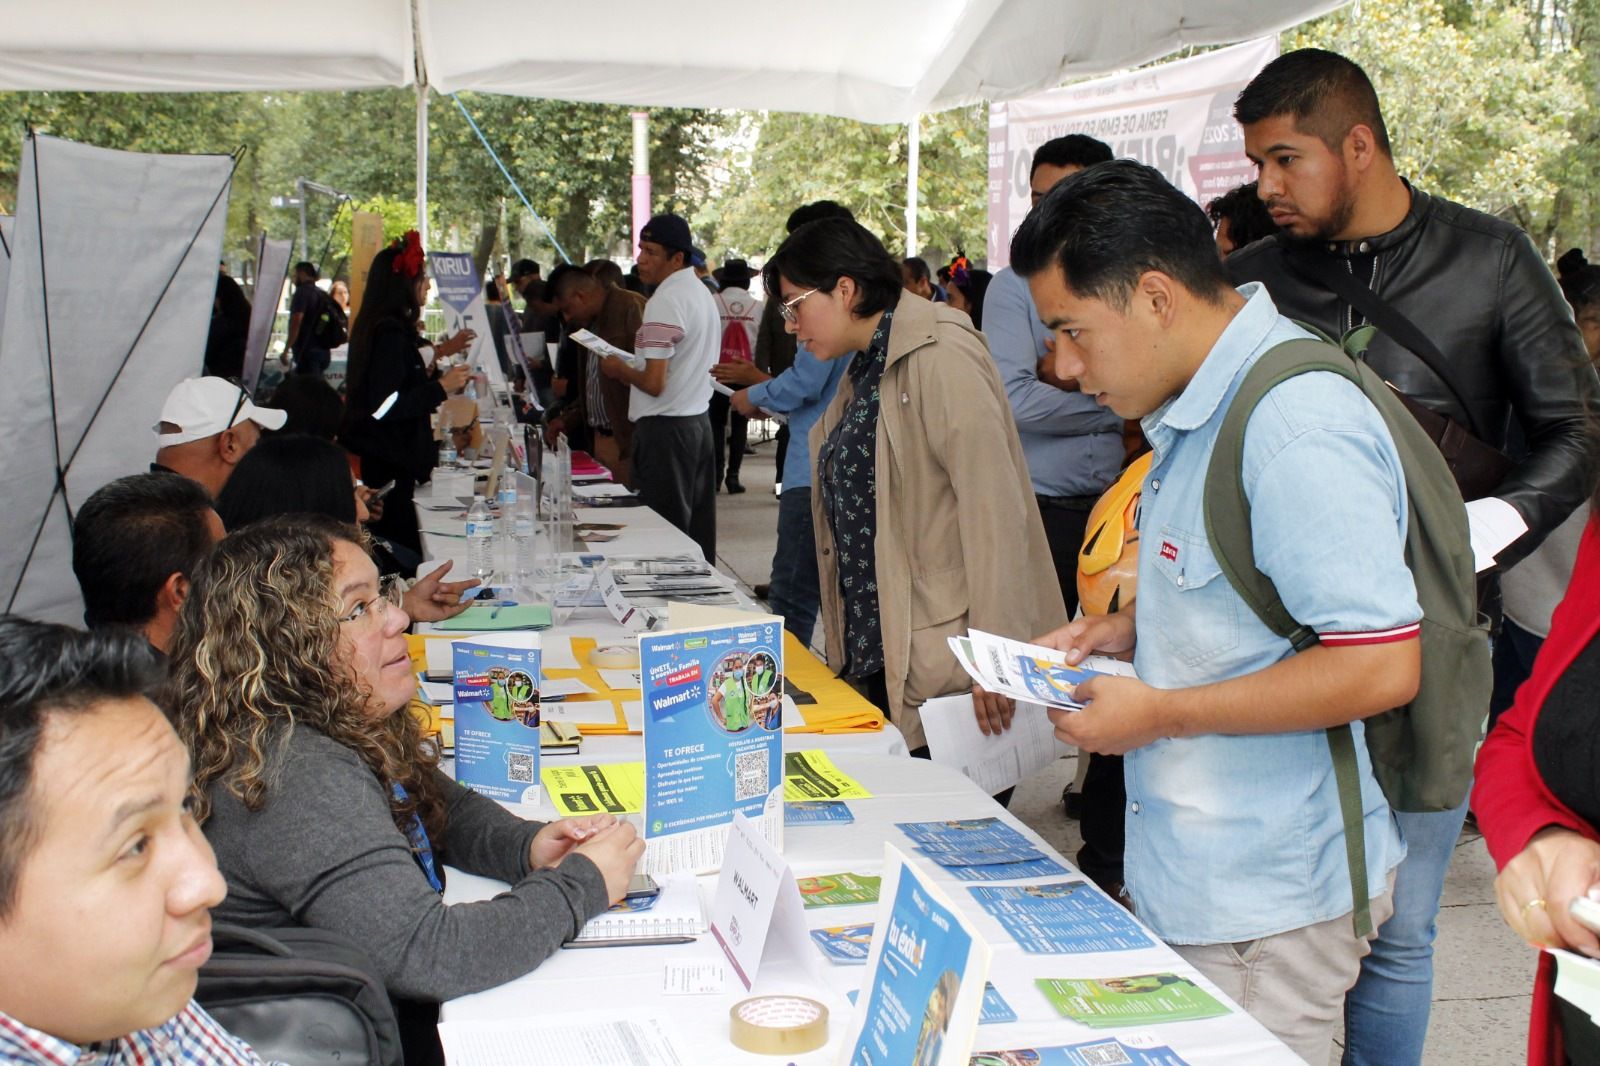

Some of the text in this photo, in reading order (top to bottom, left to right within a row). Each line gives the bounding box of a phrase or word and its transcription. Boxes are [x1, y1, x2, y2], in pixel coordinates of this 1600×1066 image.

[432, 256, 471, 276] KIRIU
[653, 688, 690, 710] Walmart
[664, 744, 704, 758] TE OFRECE
[733, 870, 758, 910] WALMART
